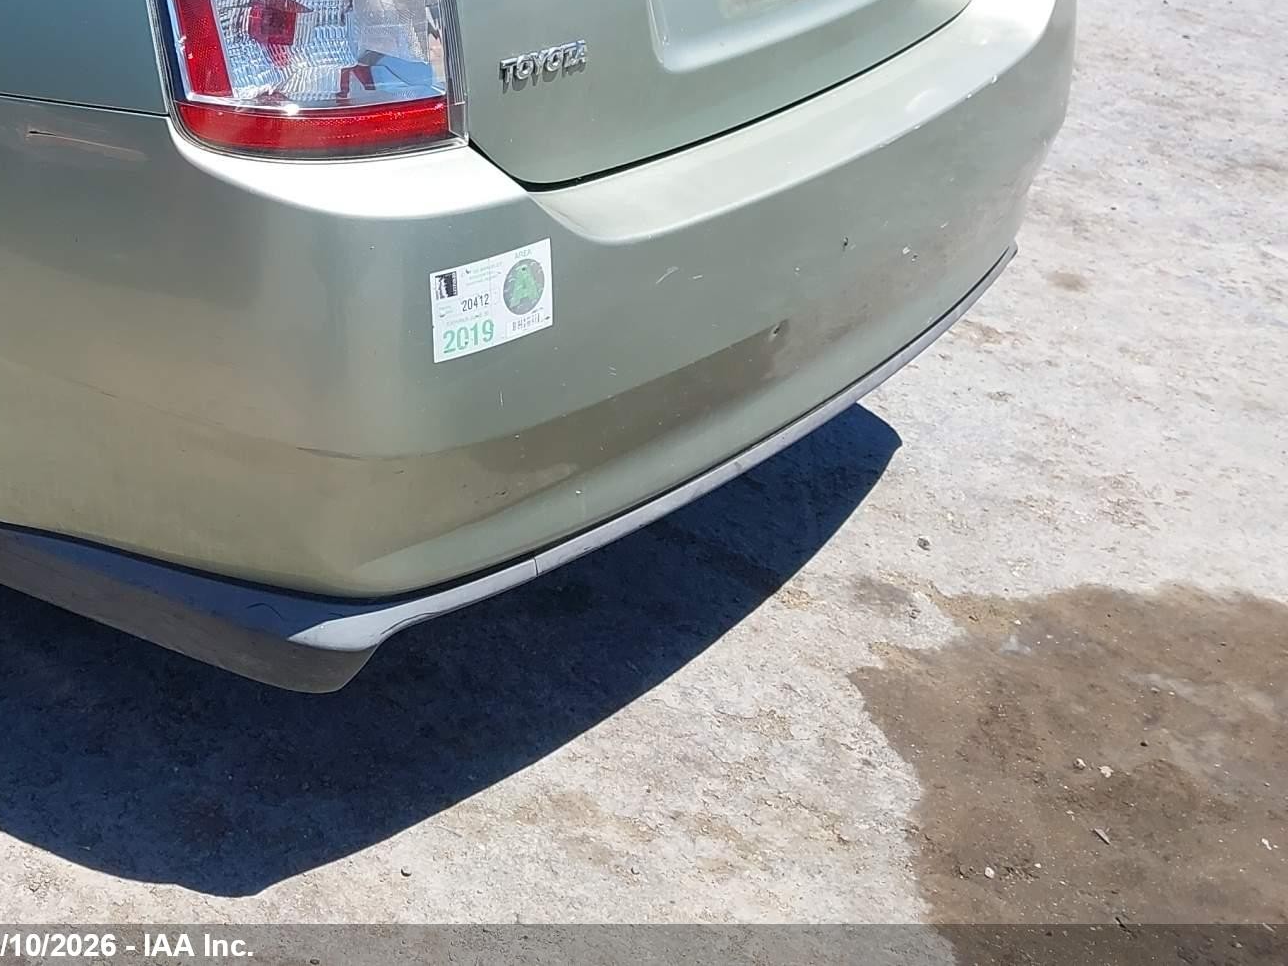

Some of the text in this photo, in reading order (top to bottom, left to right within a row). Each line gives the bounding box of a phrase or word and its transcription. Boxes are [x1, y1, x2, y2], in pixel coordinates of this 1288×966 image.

[499, 39, 586, 84] TOYOTA
[461, 293, 490, 312] 20412
[442, 318, 495, 354] 2019
